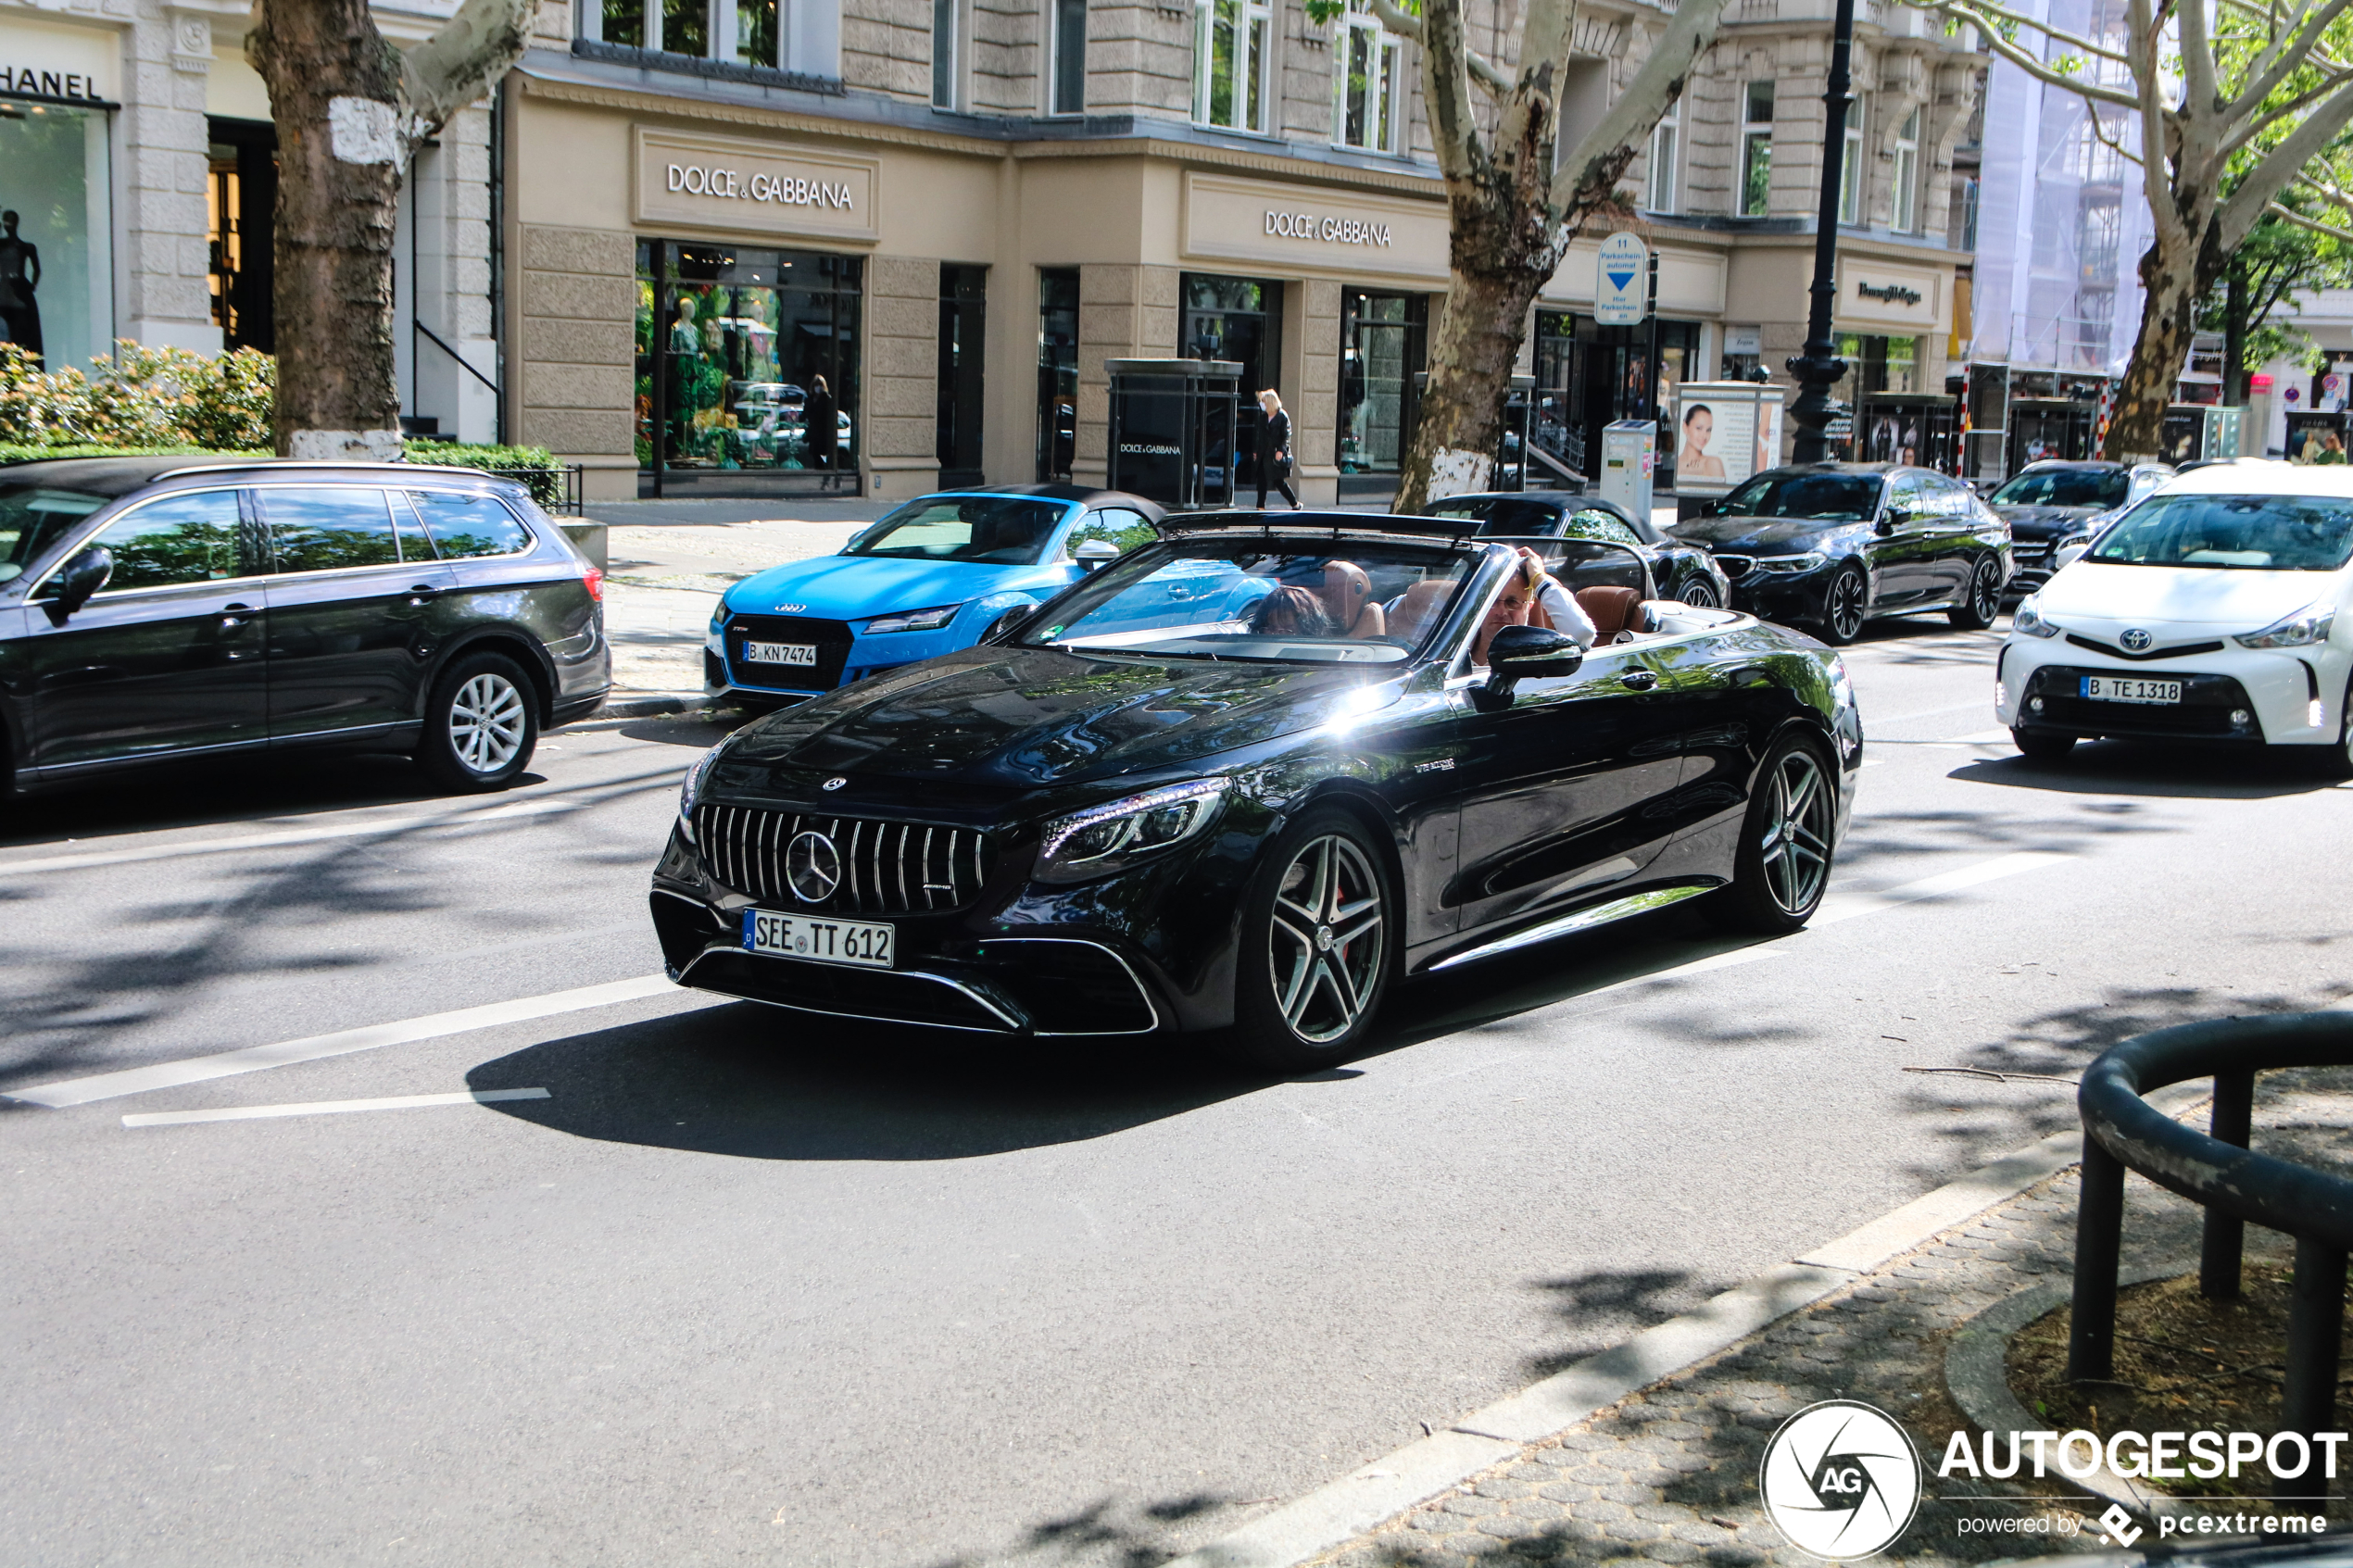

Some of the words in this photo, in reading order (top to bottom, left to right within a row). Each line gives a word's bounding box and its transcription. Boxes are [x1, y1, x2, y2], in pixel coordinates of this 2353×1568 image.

[668, 163, 736, 198] DOLCE
[740, 185, 749, 199] &
[751, 172, 853, 210] GABBANA
[1265, 210, 1313, 239] DOLCE
[1314, 227, 1320, 240] &
[1321, 217, 1391, 247] GABBANA
[1617, 238, 1628, 249] 11
[1606, 261, 1636, 270] automat
[1601, 303, 1637, 311] Parkschein
[1120, 444, 1142, 454] DOLCE
[1146, 445, 1181, 456] GABBANA
[749, 644, 757, 659] B
[764, 645, 779, 661] KN
[783, 646, 813, 663] 7474
[2090, 679, 2100, 696] B
[2112, 681, 2133, 697] TE
[2136, 682, 2179, 700] 1318
[756, 916, 793, 950] SEE
[811, 922, 838, 956] TT
[845, 927, 888, 960] 612
